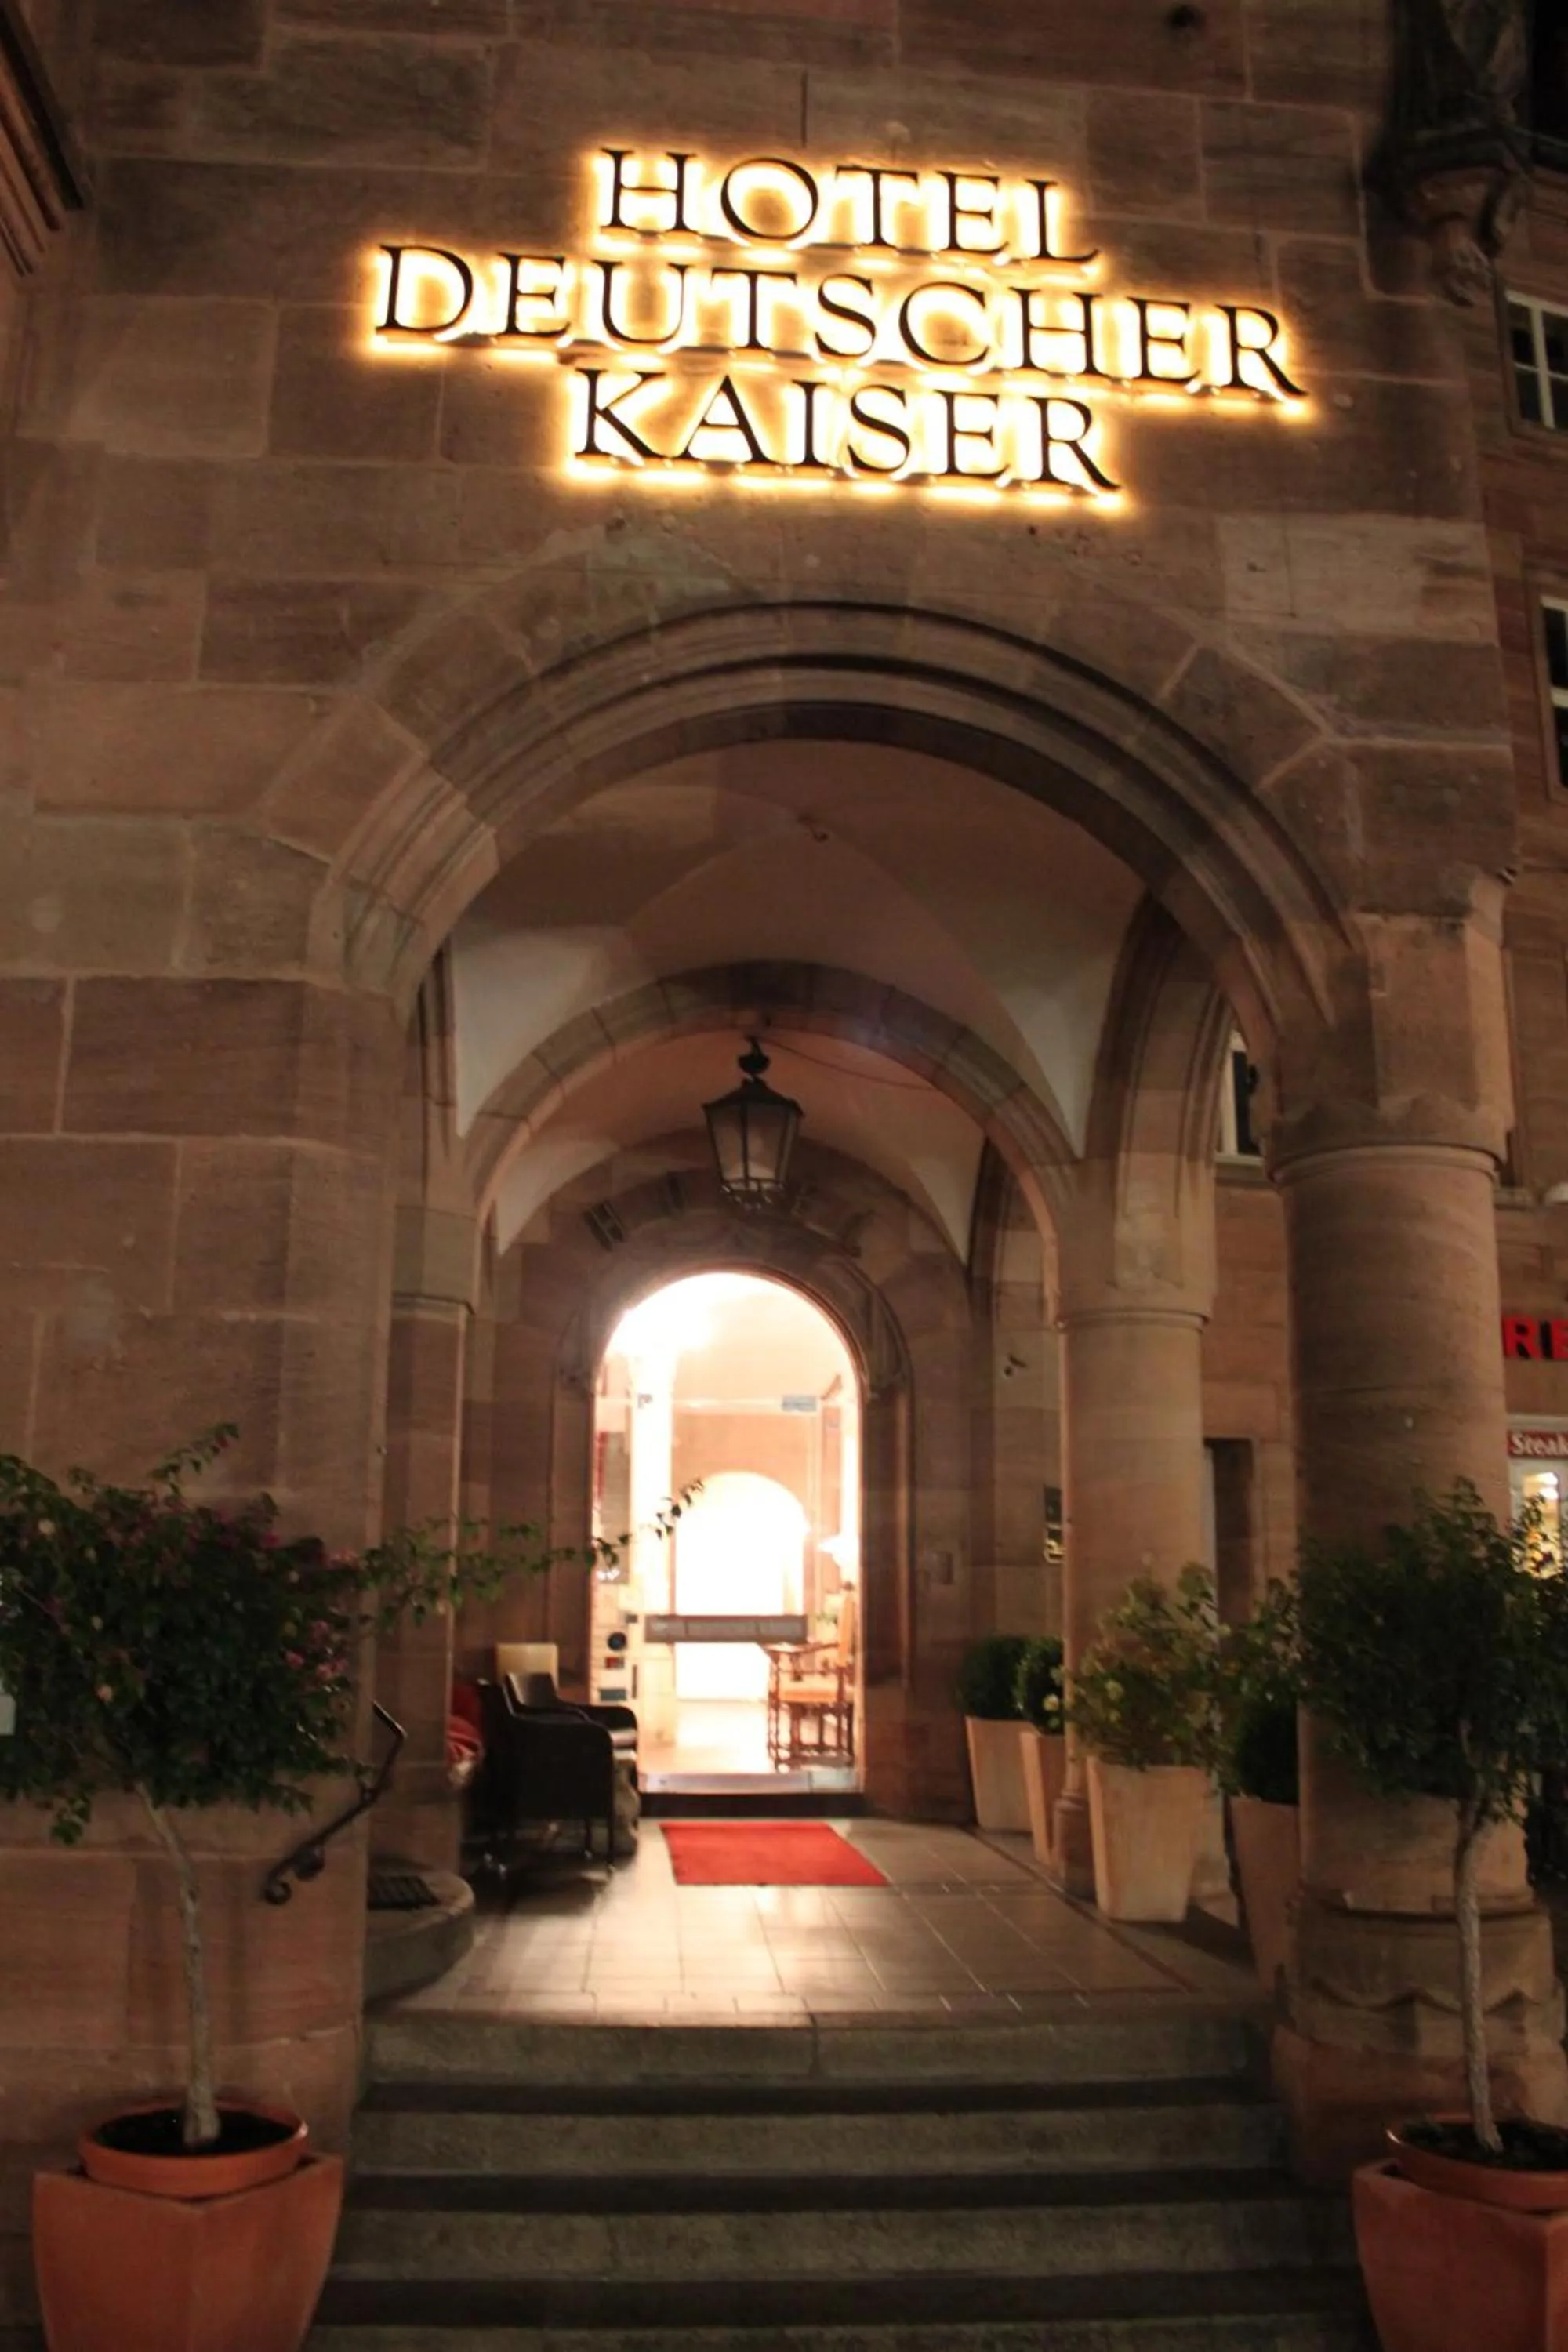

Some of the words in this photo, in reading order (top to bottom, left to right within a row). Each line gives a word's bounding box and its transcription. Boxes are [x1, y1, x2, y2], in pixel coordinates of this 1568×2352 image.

[597, 148, 1101, 263] HOTEL
[375, 245, 1309, 396] DEUTSCHER
[575, 367, 1121, 490] KAISER
